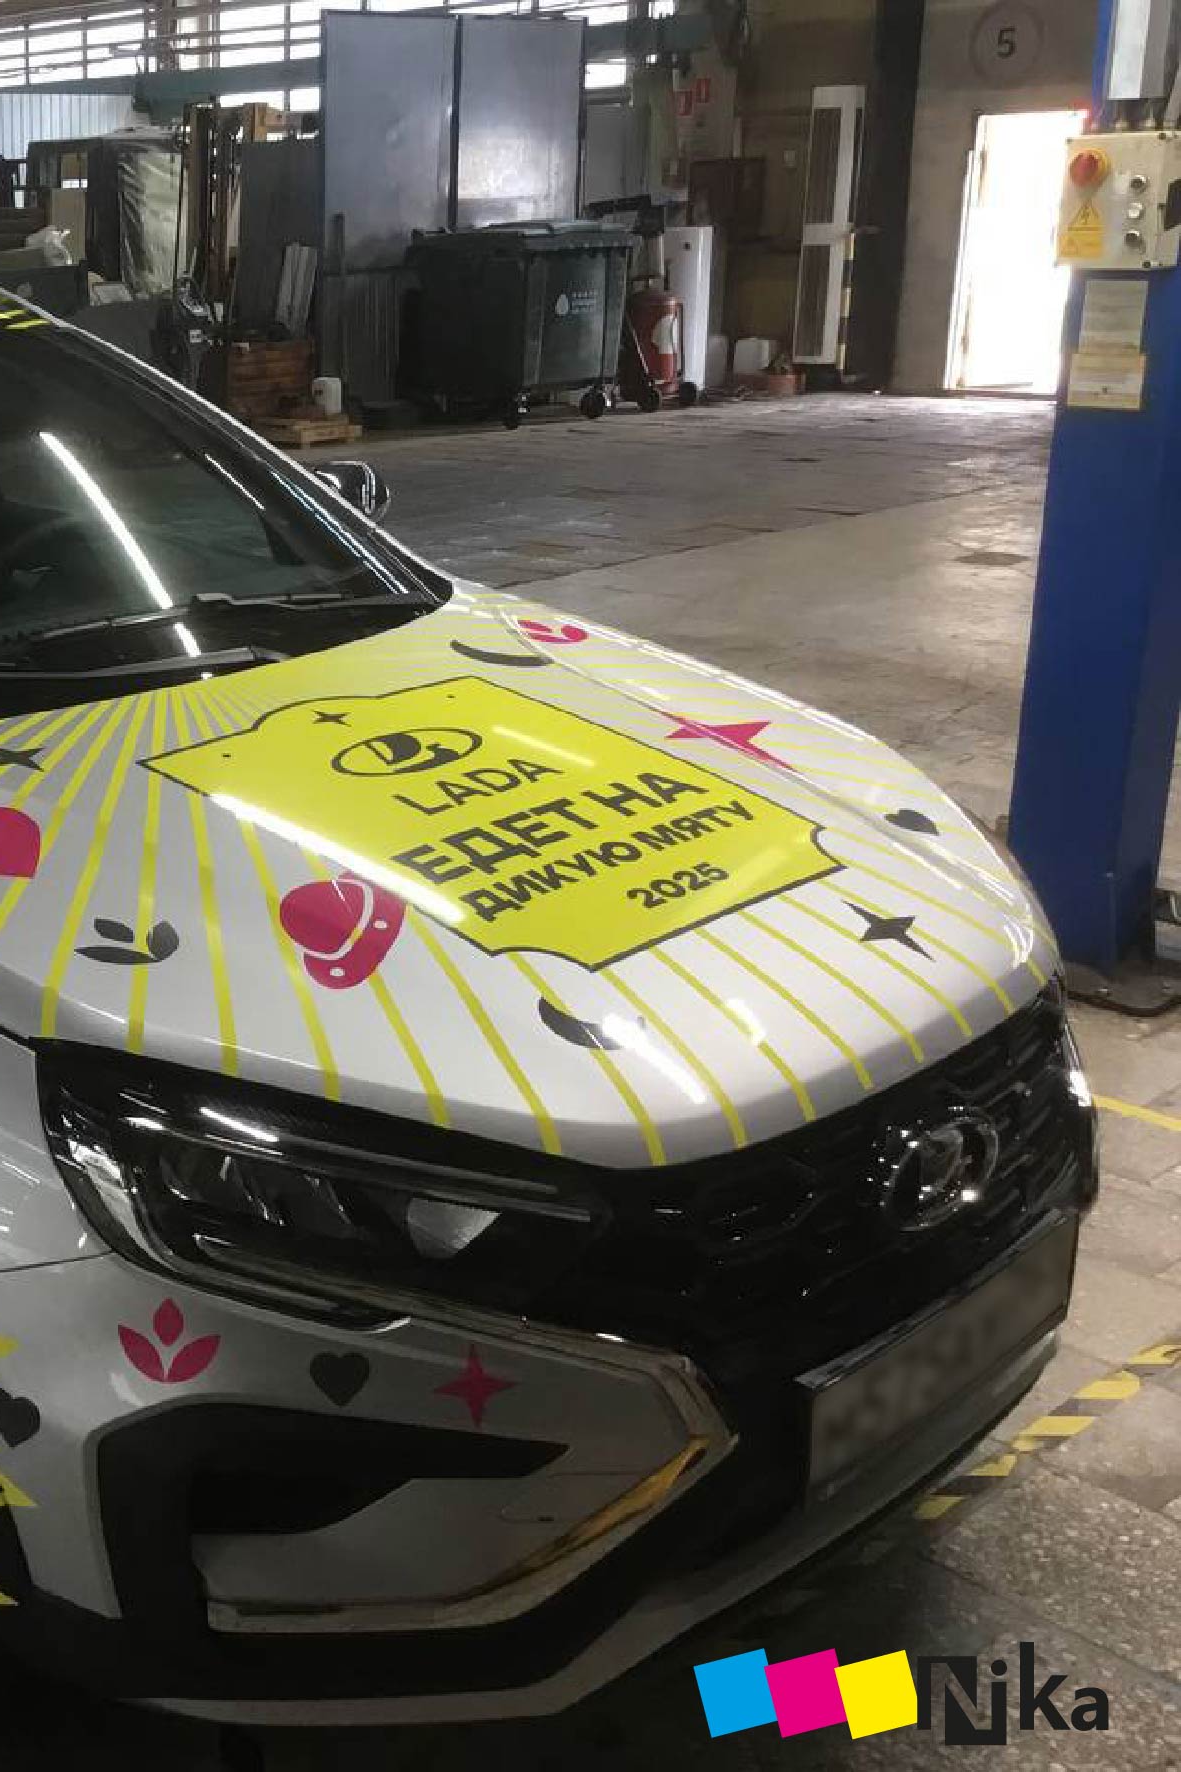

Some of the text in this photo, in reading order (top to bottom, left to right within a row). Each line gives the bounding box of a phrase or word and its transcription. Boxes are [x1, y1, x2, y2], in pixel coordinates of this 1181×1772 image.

[997, 27, 1015, 58] 5
[392, 758, 564, 816] LADA
[391, 772, 710, 885] ЕДЕТ НА
[459, 800, 754, 923] ДИКУЮ МЯТУ
[626, 862, 730, 909] 2025
